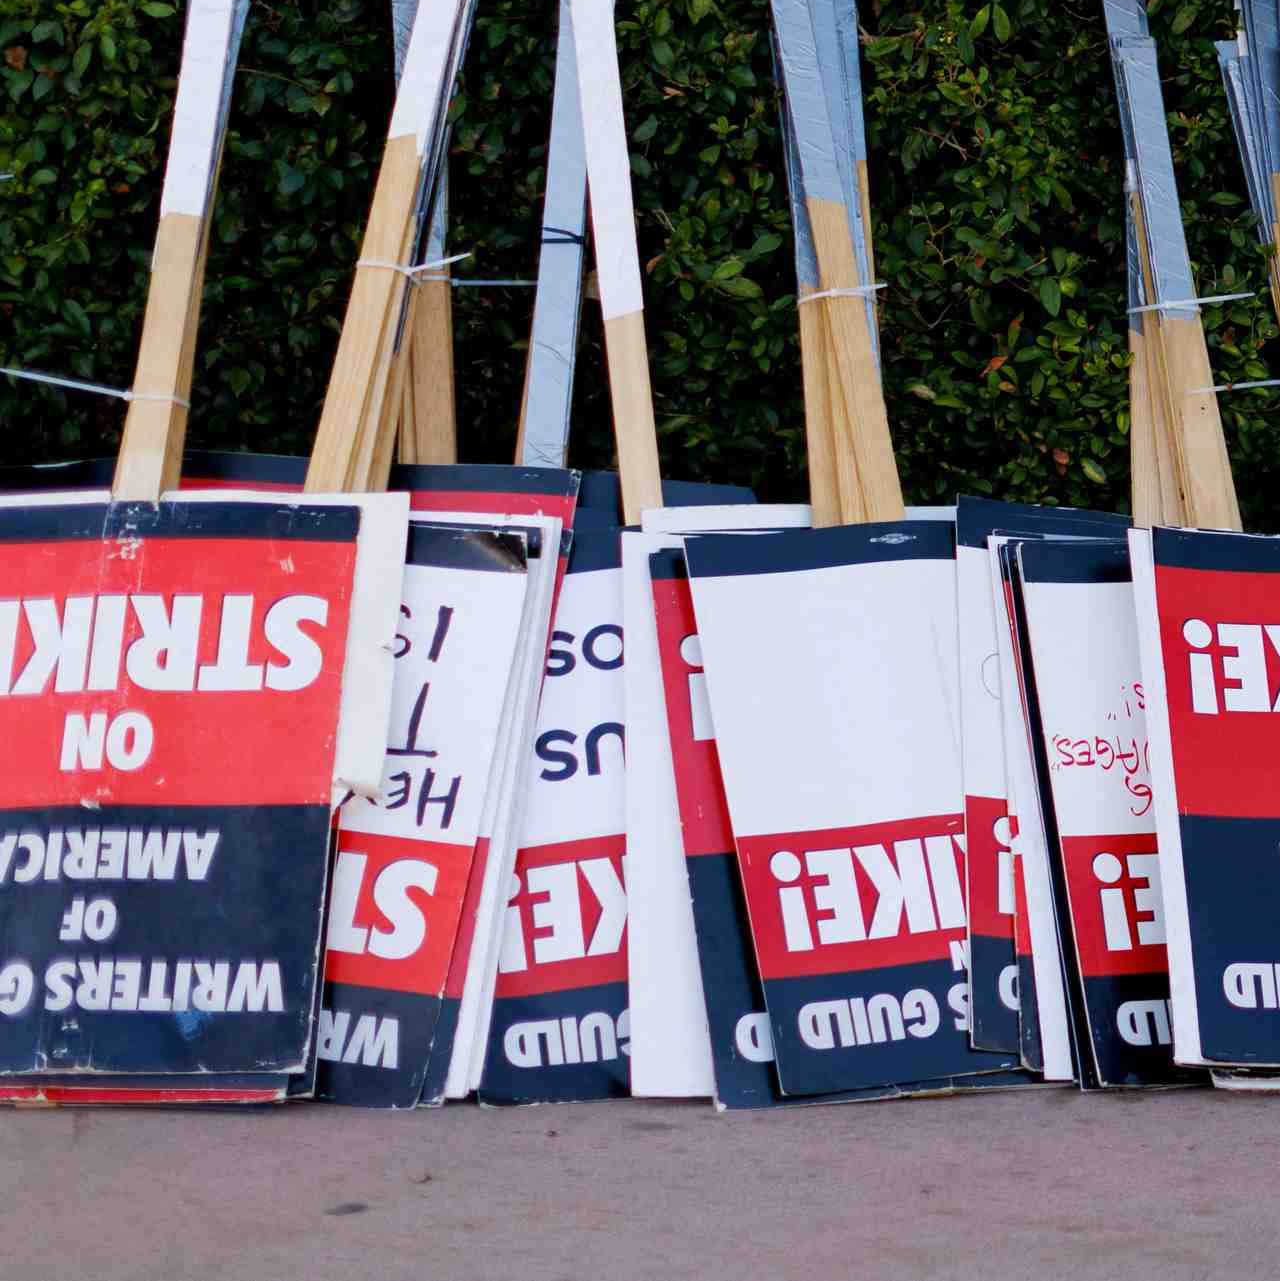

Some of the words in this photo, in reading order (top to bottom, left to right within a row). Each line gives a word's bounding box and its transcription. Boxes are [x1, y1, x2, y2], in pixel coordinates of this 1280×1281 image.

[0, 593, 329, 696] STRIK
[60, 712, 154, 772] ON
[59, 899, 118, 942] OF
[44, 960, 286, 1014] WRITERS
[798, 988, 940, 1050] GUILD
